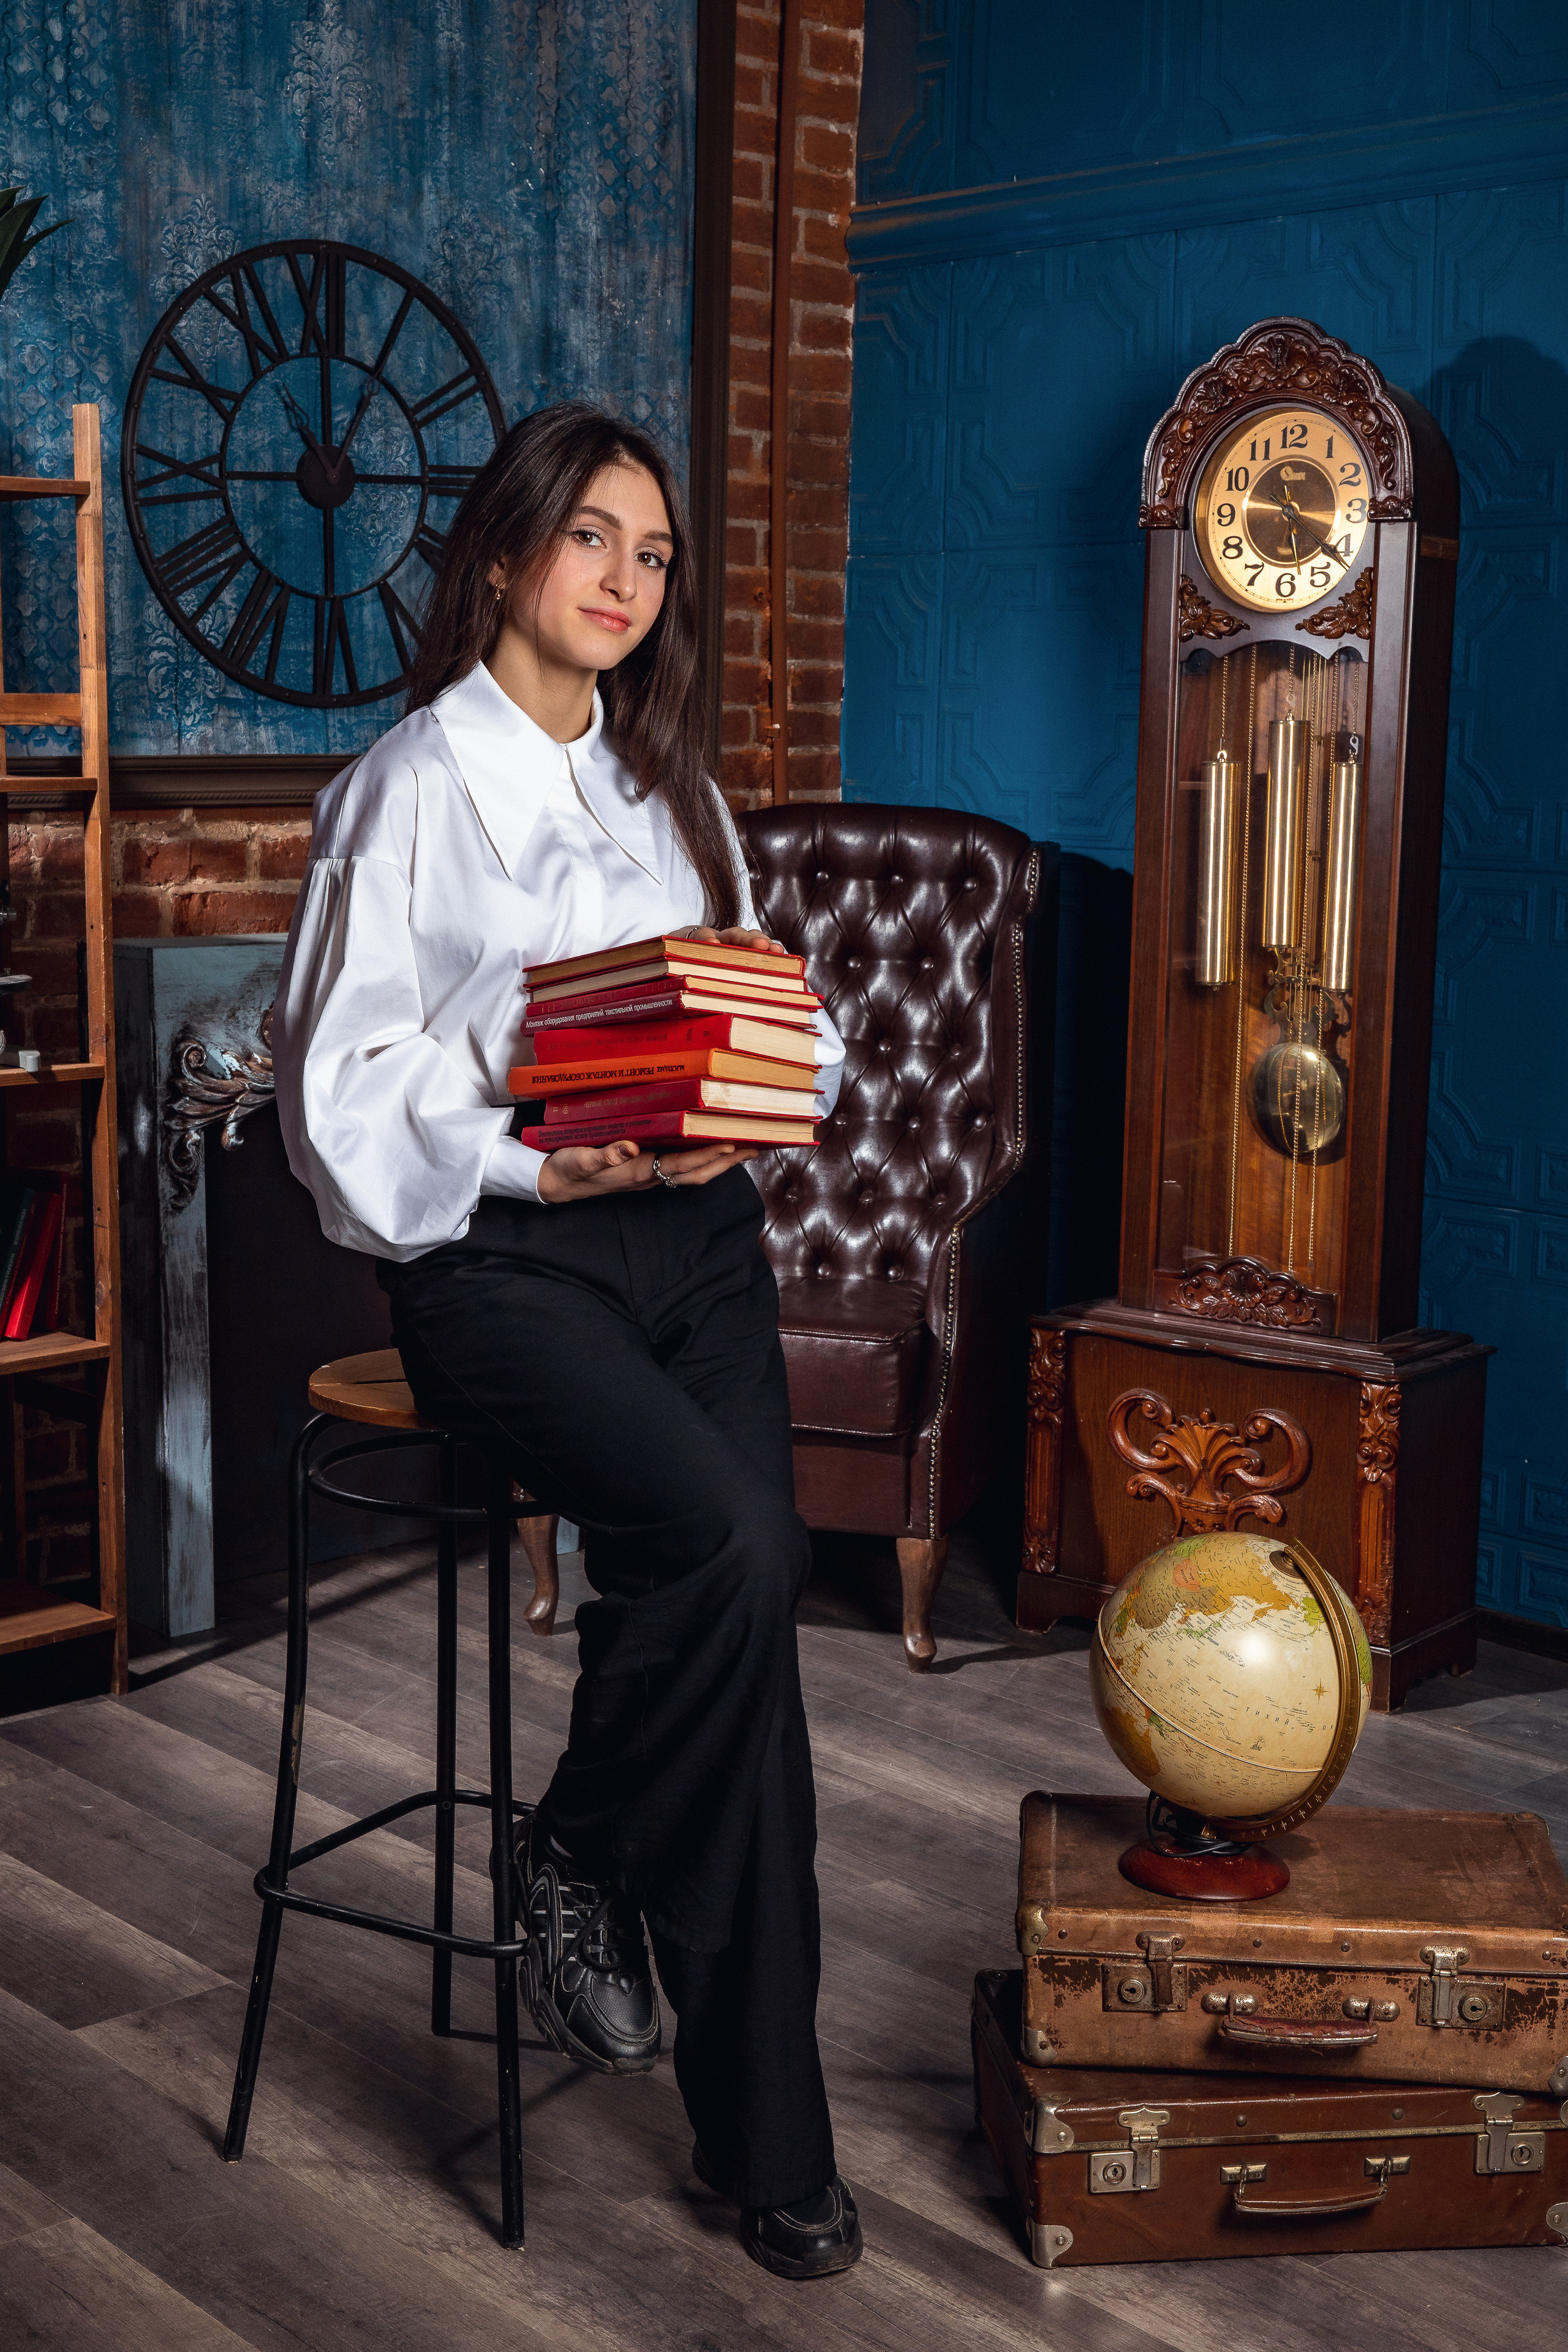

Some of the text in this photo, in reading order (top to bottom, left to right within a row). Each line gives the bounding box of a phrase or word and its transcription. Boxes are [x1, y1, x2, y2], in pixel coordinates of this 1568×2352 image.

[1249, 437, 1271, 461] 11
[1280, 424, 1308, 449] 12
[1325, 434, 1334, 459] 1
[1226, 466, 1250, 492] 10
[1339, 462, 1362, 486] 2
[1216, 503, 1236, 527] 9
[1346, 497, 1368, 524] 3
[1223, 535, 1243, 560] 8
[1334, 533, 1354, 557] 4
[1244, 562, 1264, 587] 7
[1275, 573, 1296, 598] 6
[1310, 562, 1331, 588] 5
[545, 1015, 575, 1026] оборудования
[575, 1009, 604, 1022] предприятий
[605, 1004, 633, 1016] текстильной
[634, 998, 673, 1012] промышленности
[531, 1072, 585, 1084] ОБОРУДОВАНИЯ
[586, 1070, 617, 1079] МОНТАЖ
[625, 1067, 654, 1077] РЕМОНТ
[1245, 1706, 1289, 1725] ТИХИЙ
